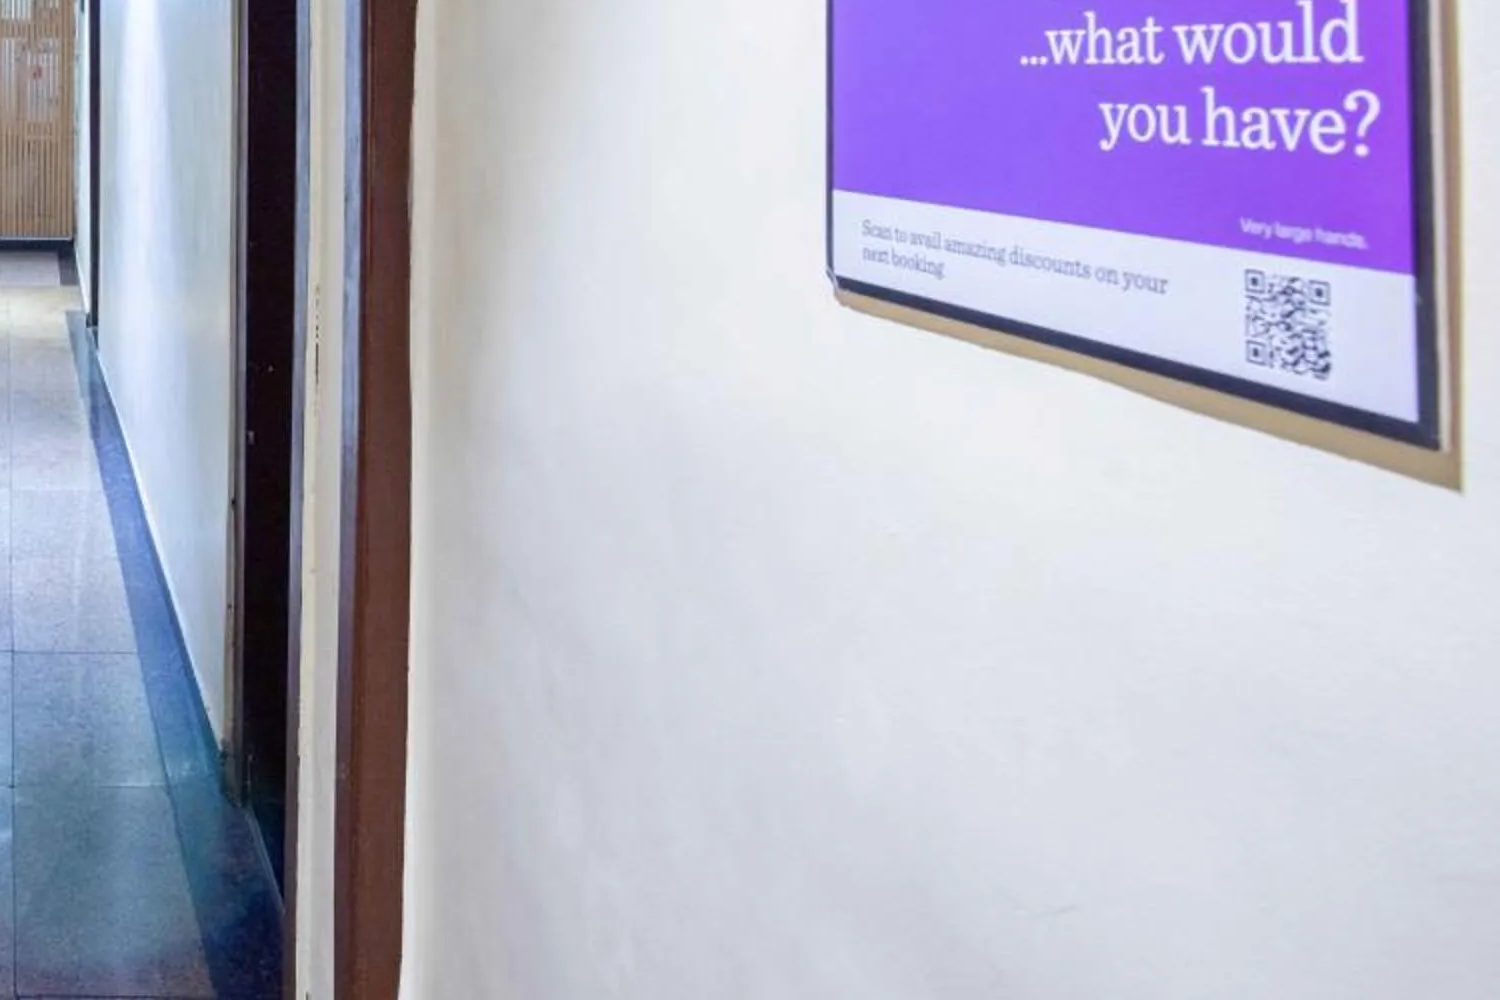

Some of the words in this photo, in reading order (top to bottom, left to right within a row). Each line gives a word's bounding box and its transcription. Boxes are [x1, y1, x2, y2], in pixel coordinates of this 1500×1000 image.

[1097, 101, 1192, 151] you
[1200, 86, 1381, 158] have?
[862, 246, 890, 265] next
[862, 218, 893, 241] Scan
[894, 228, 907, 244] to
[910, 231, 942, 250] avail
[944, 238, 1007, 267] amazing
[1008, 245, 1092, 280] discounts
[1095, 266, 1119, 285] on
[1122, 270, 1169, 295] your
